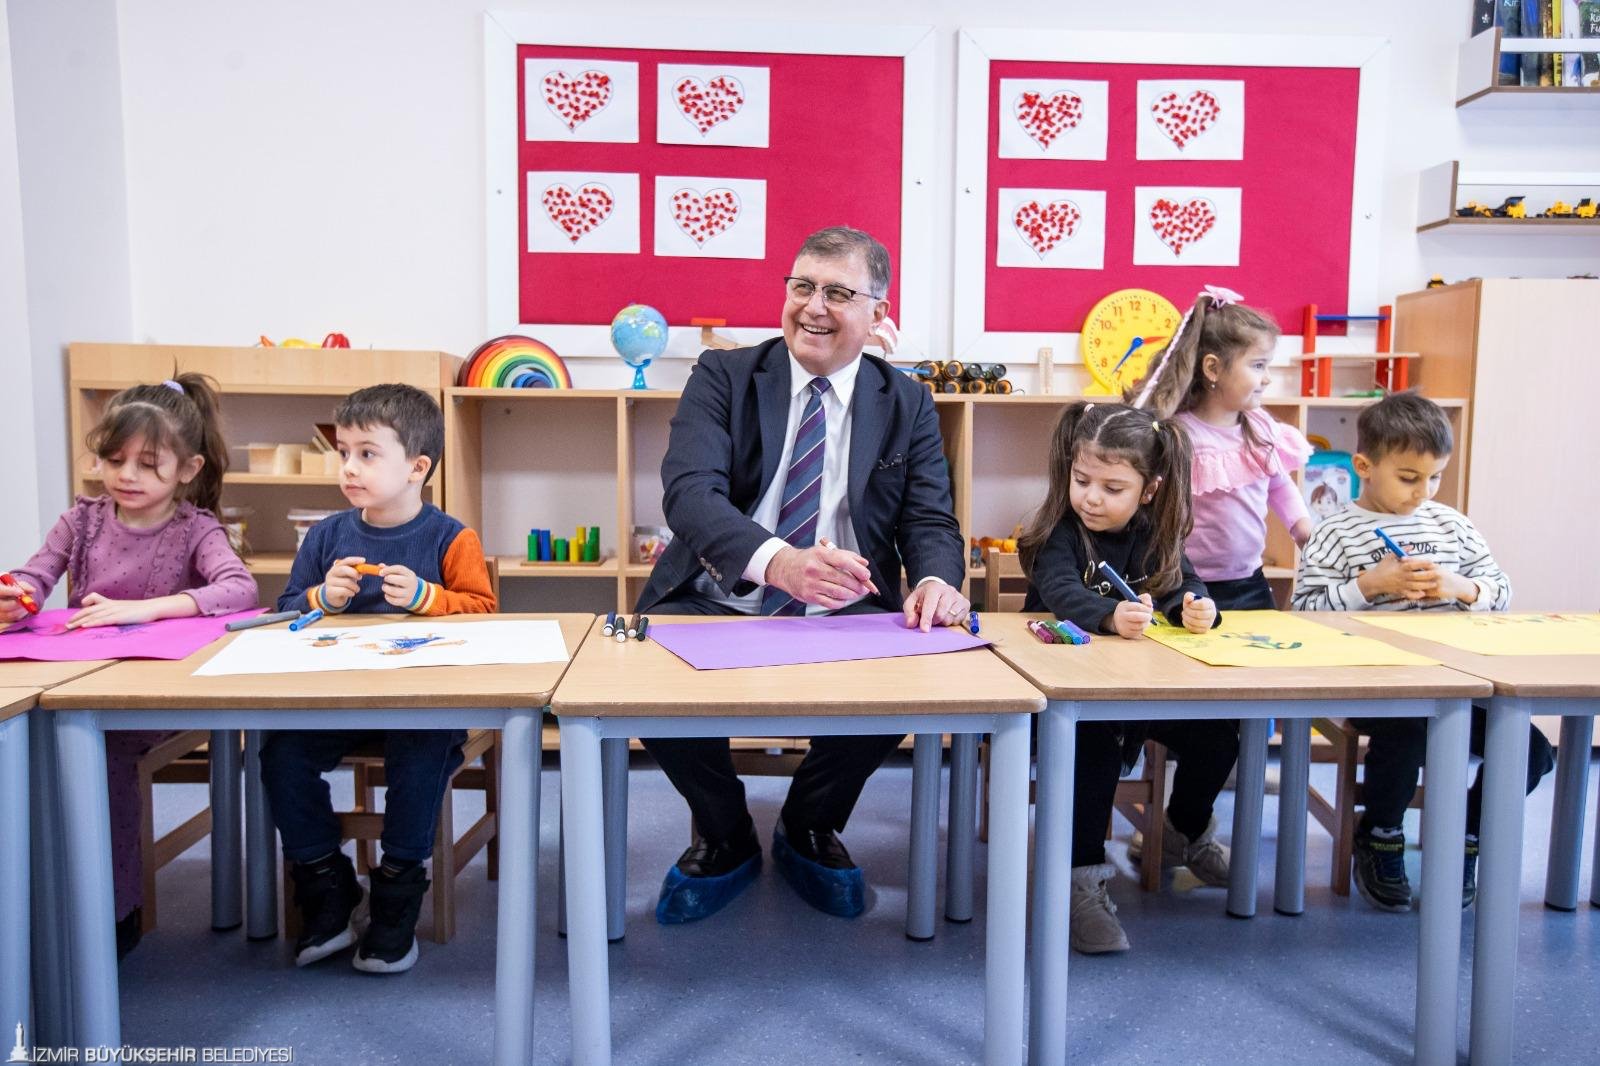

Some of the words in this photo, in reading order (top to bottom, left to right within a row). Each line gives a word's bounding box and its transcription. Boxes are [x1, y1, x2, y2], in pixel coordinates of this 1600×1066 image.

[1113, 306, 1122, 316] 11
[1130, 301, 1141, 311] 12
[1152, 303, 1157, 313] 1
[1100, 320, 1112, 330] 10
[1165, 318, 1171, 328] 2
[1094, 338, 1101, 348] 9
[1101, 358, 1108, 368] 8
